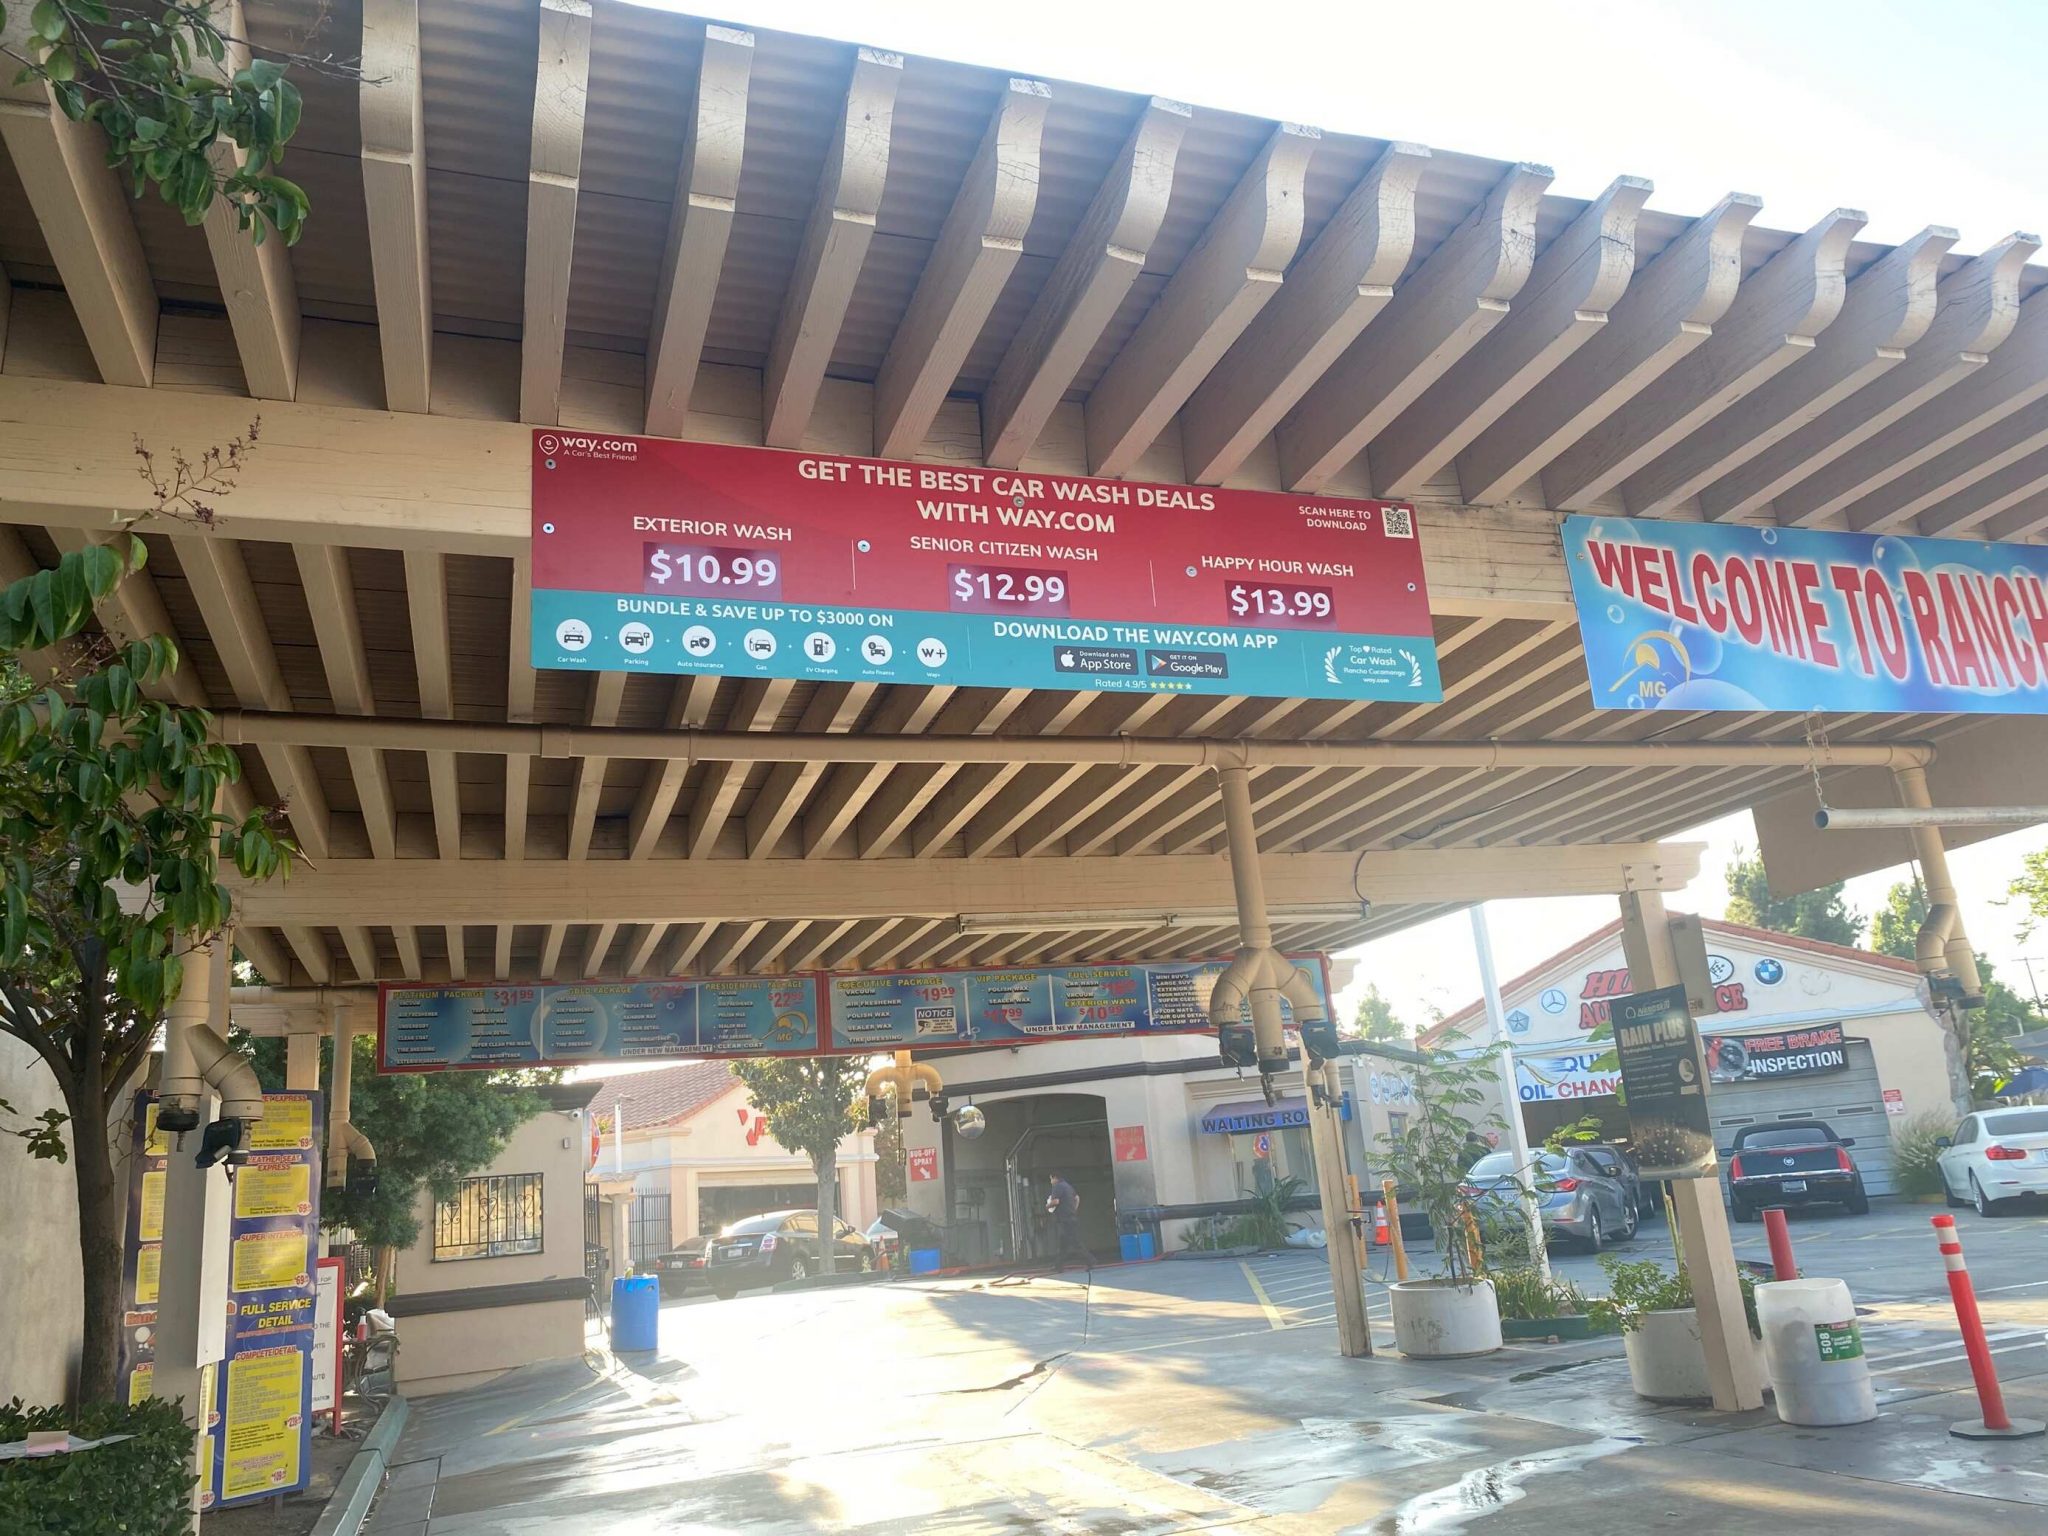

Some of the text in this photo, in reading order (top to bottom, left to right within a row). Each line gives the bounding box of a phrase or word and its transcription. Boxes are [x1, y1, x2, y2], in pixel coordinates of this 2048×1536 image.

[561, 436, 637, 453] way.com
[612, 453, 637, 461] Friend!
[798, 459, 1215, 511] GET THE BEST CAR WASH DEALS
[916, 500, 1115, 533] WITH WAY.COM
[1298, 505, 1371, 520] SCAN HERE TO
[633, 516, 792, 541] EXTERIOR WASH
[1306, 518, 1368, 532] DOWNLOAD
[910, 536, 1098, 561] SENIOR CITIZEN WASH
[650, 549, 777, 587] $10.99
[1201, 556, 1354, 577] HAPPY HOUR WASH
[954, 569, 1065, 602] $12.99
[1231, 585, 1331, 617] $13.99
[617, 598, 893, 627] BUNDLE & SAVE UP TO $3000 ON
[1586, 538, 1839, 669] WELCOME
[1830, 566, 1908, 681] TO
[993, 621, 1278, 649] DOWNLOAD THE WAY.COM APP
[1079, 650, 1109, 659] Download
[1349, 645, 1392, 654] Top Rated
[624, 658, 649, 666] Parking
[1080, 658, 1131, 670] App Store
[1350, 656, 1396, 666] Car Wash
[1170, 662, 1223, 675] Google Play
[1369, 668, 1406, 677] Cucamonga
[1095, 678, 1147, 689] Rated 4.9/5
[1639, 679, 1667, 699] MG
[995, 973, 1037, 981] PACKAGE
[1068, 970, 1130, 979] FULL SERVICE
[837, 977, 943, 989] EXECUTIVE PACKAGE
[444, 990, 485, 998] PACKAGE
[1065, 998, 1137, 1008] EXTERIOR WASH
[918, 1009, 952, 1018] NOTICE
[1025, 1025, 1054, 1033] UNDER
[1076, 1022, 1132, 1030] MANAGEMENT
[1620, 1018, 1686, 1048] RAIN PLUS
[1744, 1027, 1842, 1052] FREE BRAKE
[1751, 1050, 1844, 1073] INSPECTION
[1520, 1084, 1553, 1101] OIL
[1202, 1113, 1276, 1132] WAITING
[913, 1158, 932, 1166] SPRAY
[241, 1298, 312, 1316] FULL SERVICE
[258, 1315, 293, 1328] DETAIL
[236, 1349, 273, 1360] COMPLETE
